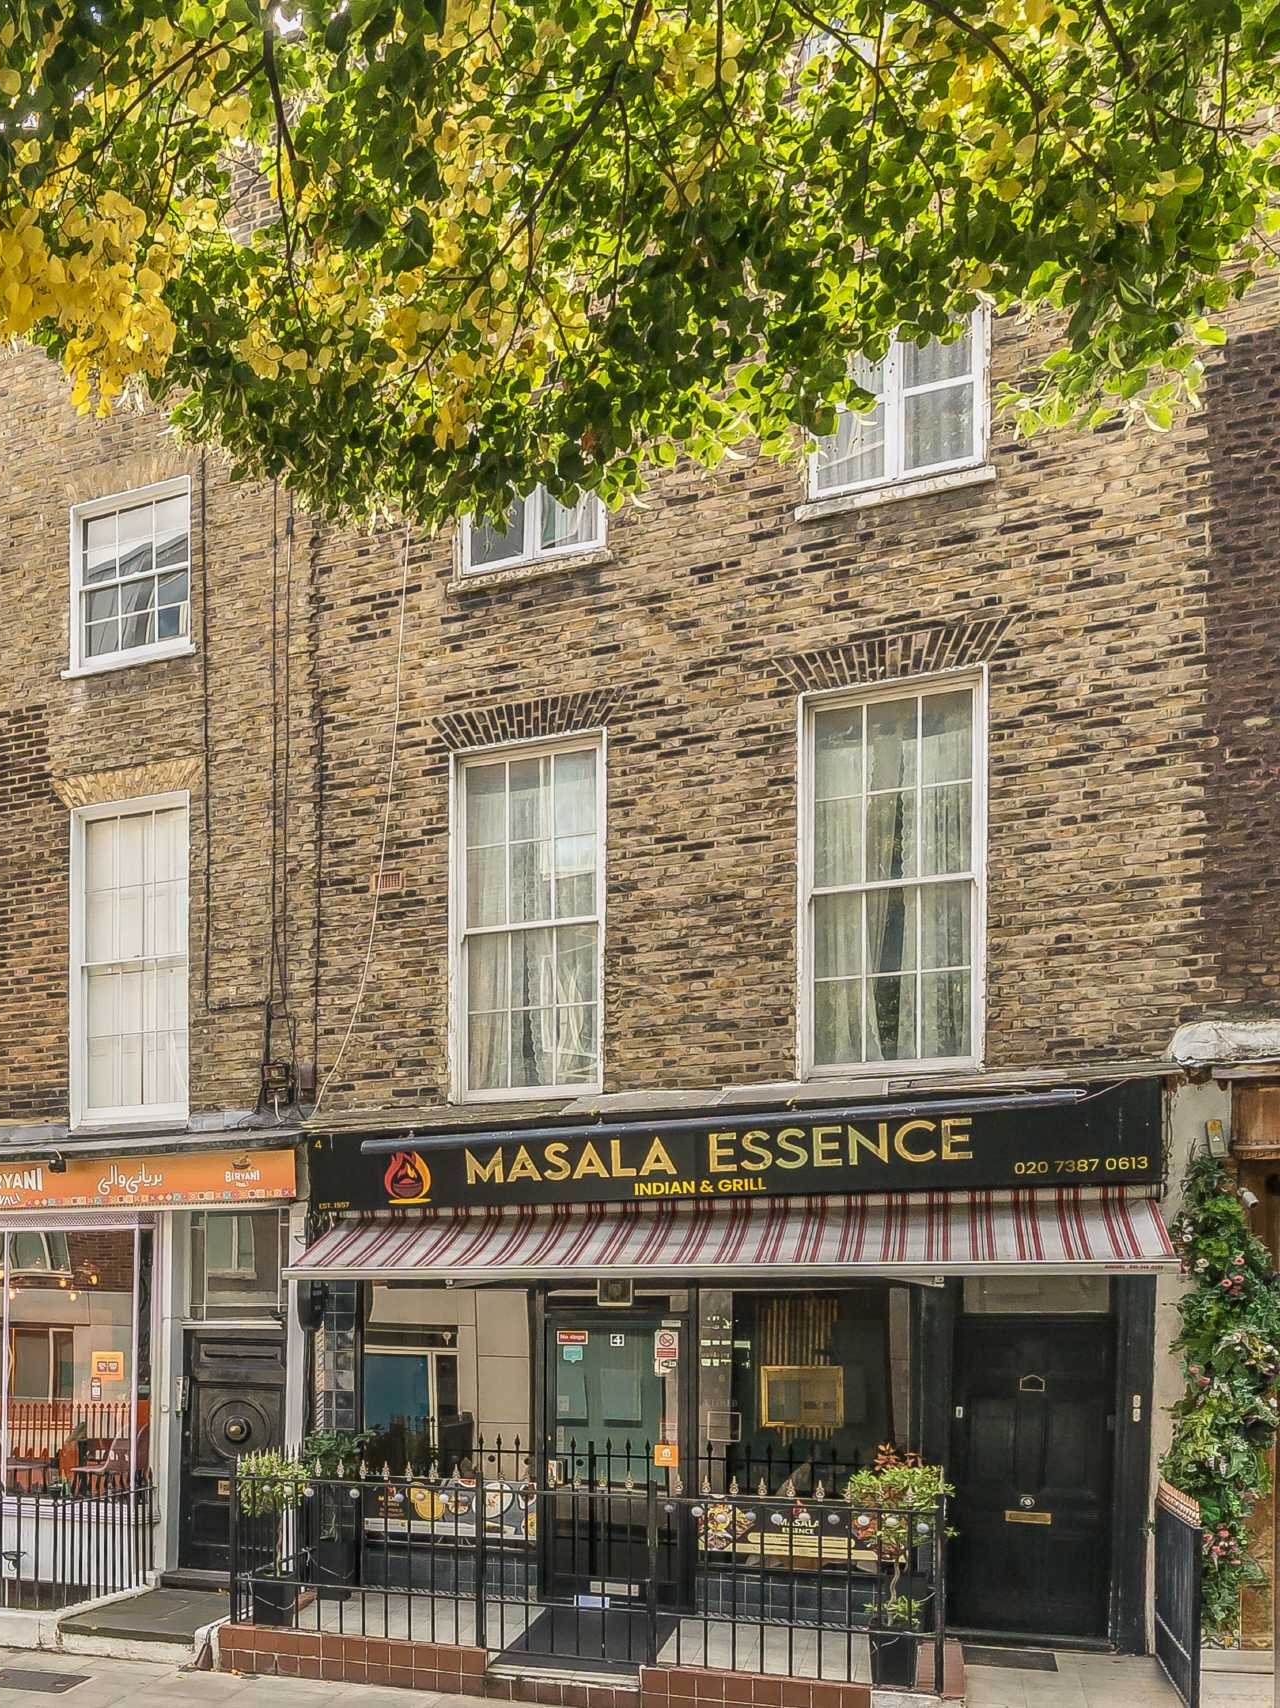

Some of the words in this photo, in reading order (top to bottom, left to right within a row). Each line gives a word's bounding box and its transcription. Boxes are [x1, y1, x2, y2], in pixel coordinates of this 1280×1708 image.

[464, 1135, 678, 1185] MASALA
[708, 1117, 973, 1173] ESSENCE
[1014, 1161, 1049, 1175] 020
[1054, 1158, 1100, 1174] 7387
[1105, 1156, 1149, 1171] 0613
[225, 1169, 261, 1183] BIRYANI
[634, 1181, 696, 1196] INDIAN
[699, 1179, 714, 1193] &
[717, 1177, 766, 1192] GRILL
[777, 1518, 820, 1528] MSALA
